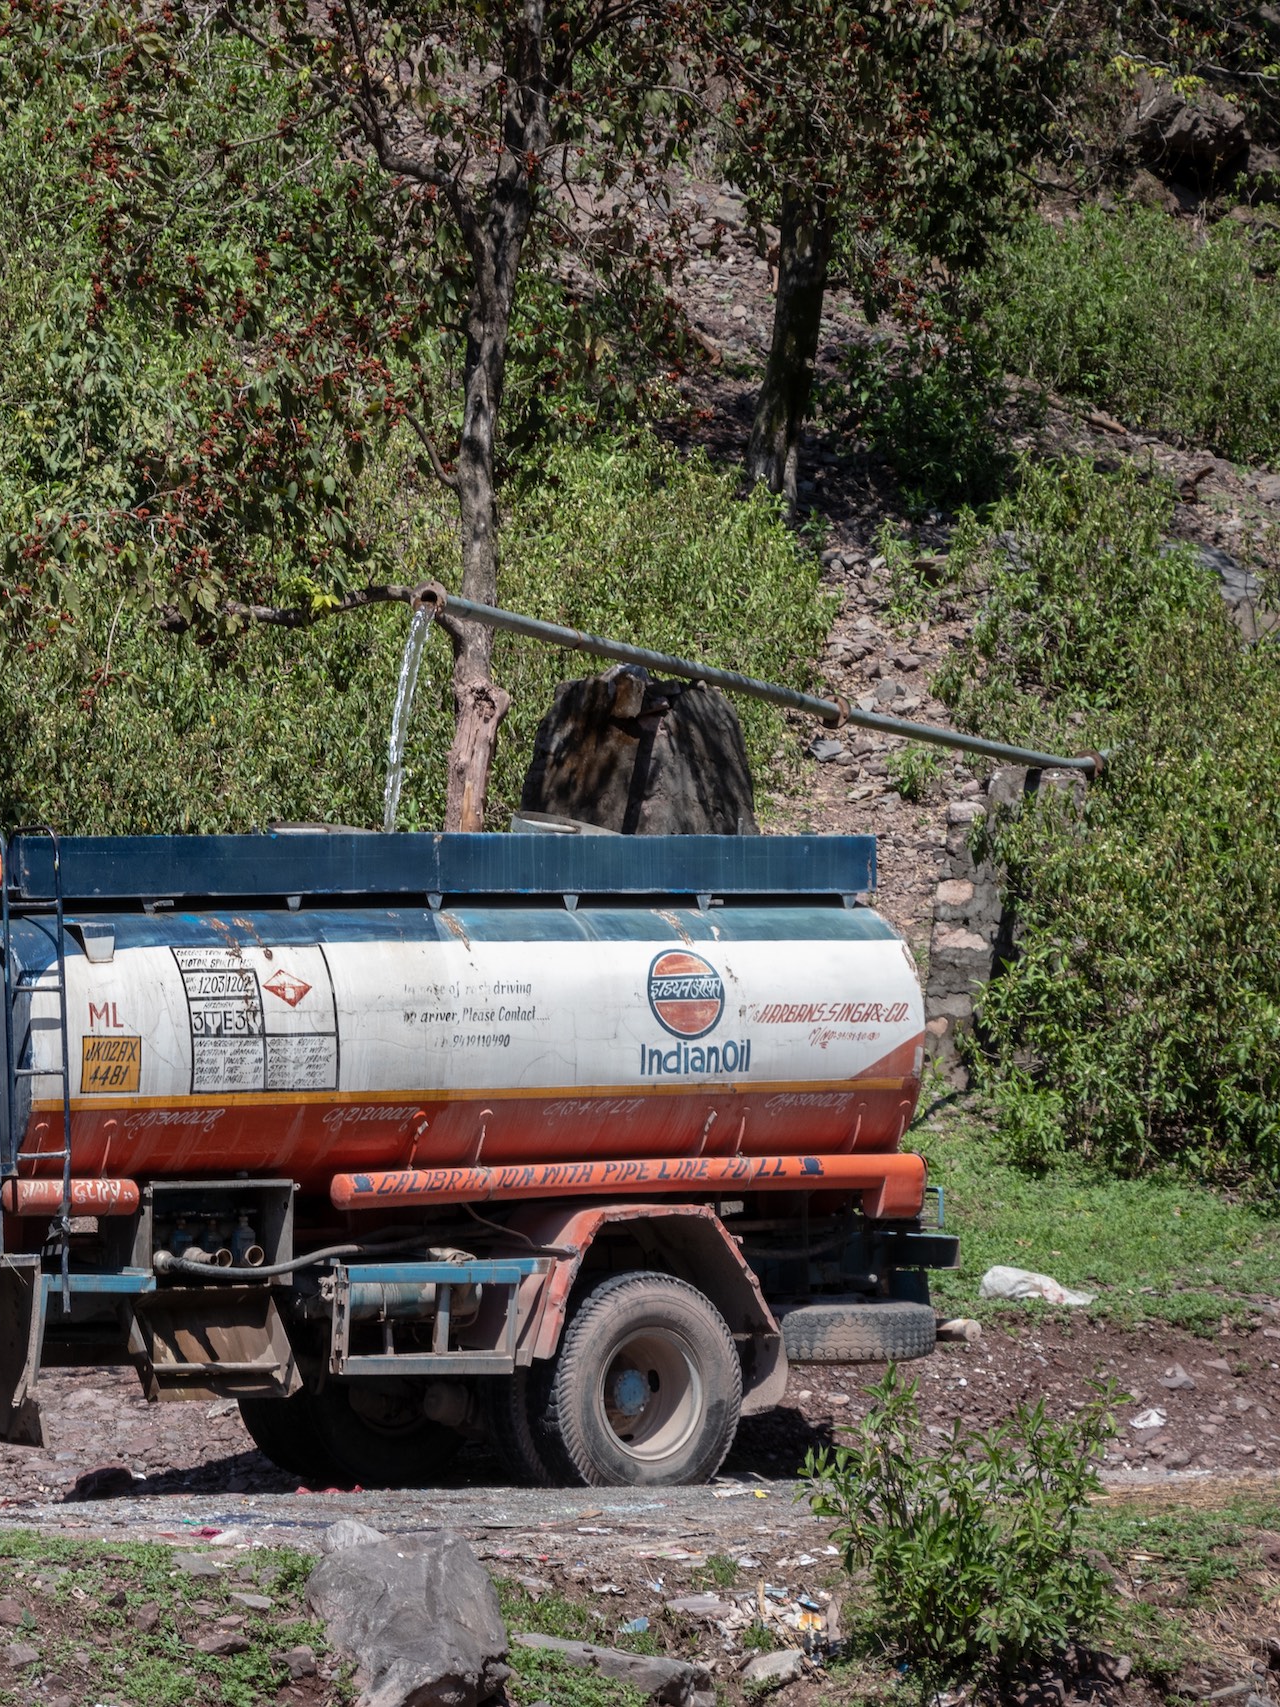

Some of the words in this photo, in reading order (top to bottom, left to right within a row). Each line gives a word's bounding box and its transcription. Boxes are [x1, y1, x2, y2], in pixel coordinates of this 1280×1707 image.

[198, 976, 225, 994] 1203
[448, 981, 460, 999] of
[493, 980, 532, 999] driving
[88, 1002, 124, 1028] ML
[462, 1007, 495, 1023] Please
[757, 1003, 827, 1023] HARBANS
[543, 1164, 593, 1186] WITH
[601, 1161, 651, 1184] PIPE
[656, 1159, 709, 1181] LINE
